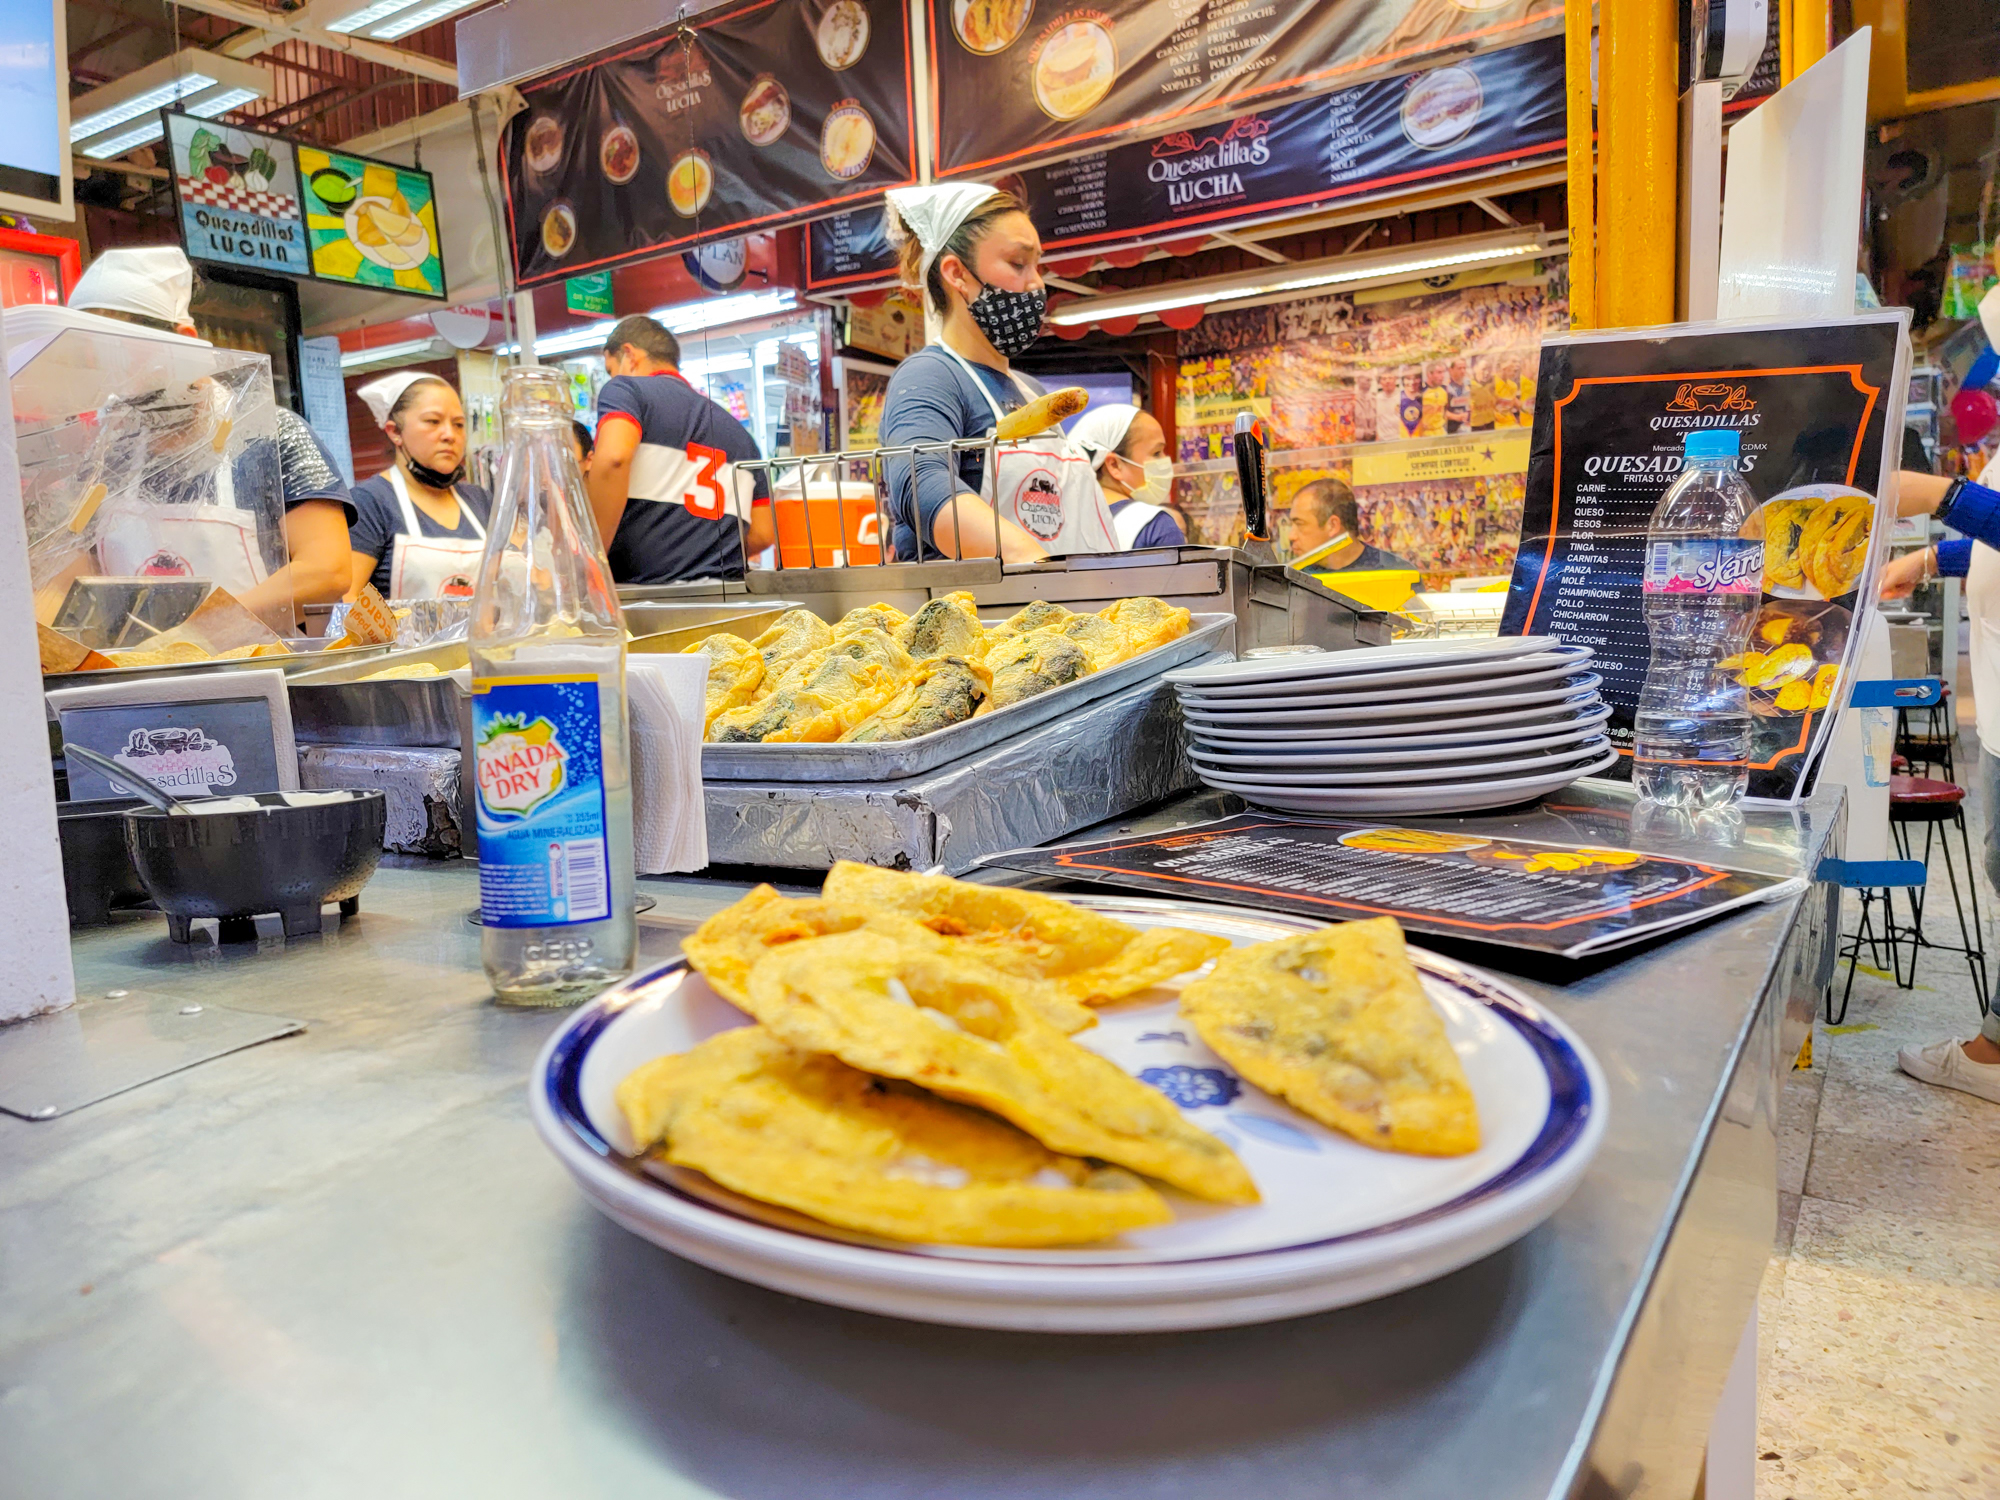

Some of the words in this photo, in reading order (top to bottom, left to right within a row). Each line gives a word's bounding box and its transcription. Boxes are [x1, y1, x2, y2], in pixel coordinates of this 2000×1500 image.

[1168, 172, 1245, 206] LUCHA
[1650, 413, 1761, 431] QUESADILLAS
[1653, 444, 1684, 452] Mercado
[1741, 443, 1768, 451] CDMX
[683, 441, 727, 520] 3
[1624, 474, 1655, 483] FRITAS
[1656, 474, 1664, 483] O
[1577, 484, 1606, 493] CARNE
[1575, 496, 1598, 505] PAPA
[1574, 508, 1604, 517] QUESO
[1573, 520, 1602, 529] SESOS
[1571, 532, 1594, 540] FLOR
[1570, 543, 1595, 551] TINGA
[1567, 554, 1609, 564] CARNITAS
[1564, 566, 1591, 575] PANZA
[1561, 576, 1586, 585] MOLÉ
[1558, 587, 1621, 599] CHAMPIÑONES
[1706, 597, 1723, 606] $25
[1555, 598, 1584, 608] POLLO
[1703, 609, 1720, 619] $25
[1552, 610, 1610, 622] CHICHARRON
[1700, 621, 1717, 631] $25
[1549, 621, 1579, 632] FRIJOL
[1694, 645, 1711, 655] $25
[1592, 662, 1624, 671] QUESO
[478, 741, 564, 789] CANADA
[495, 768, 541, 800] DRY
